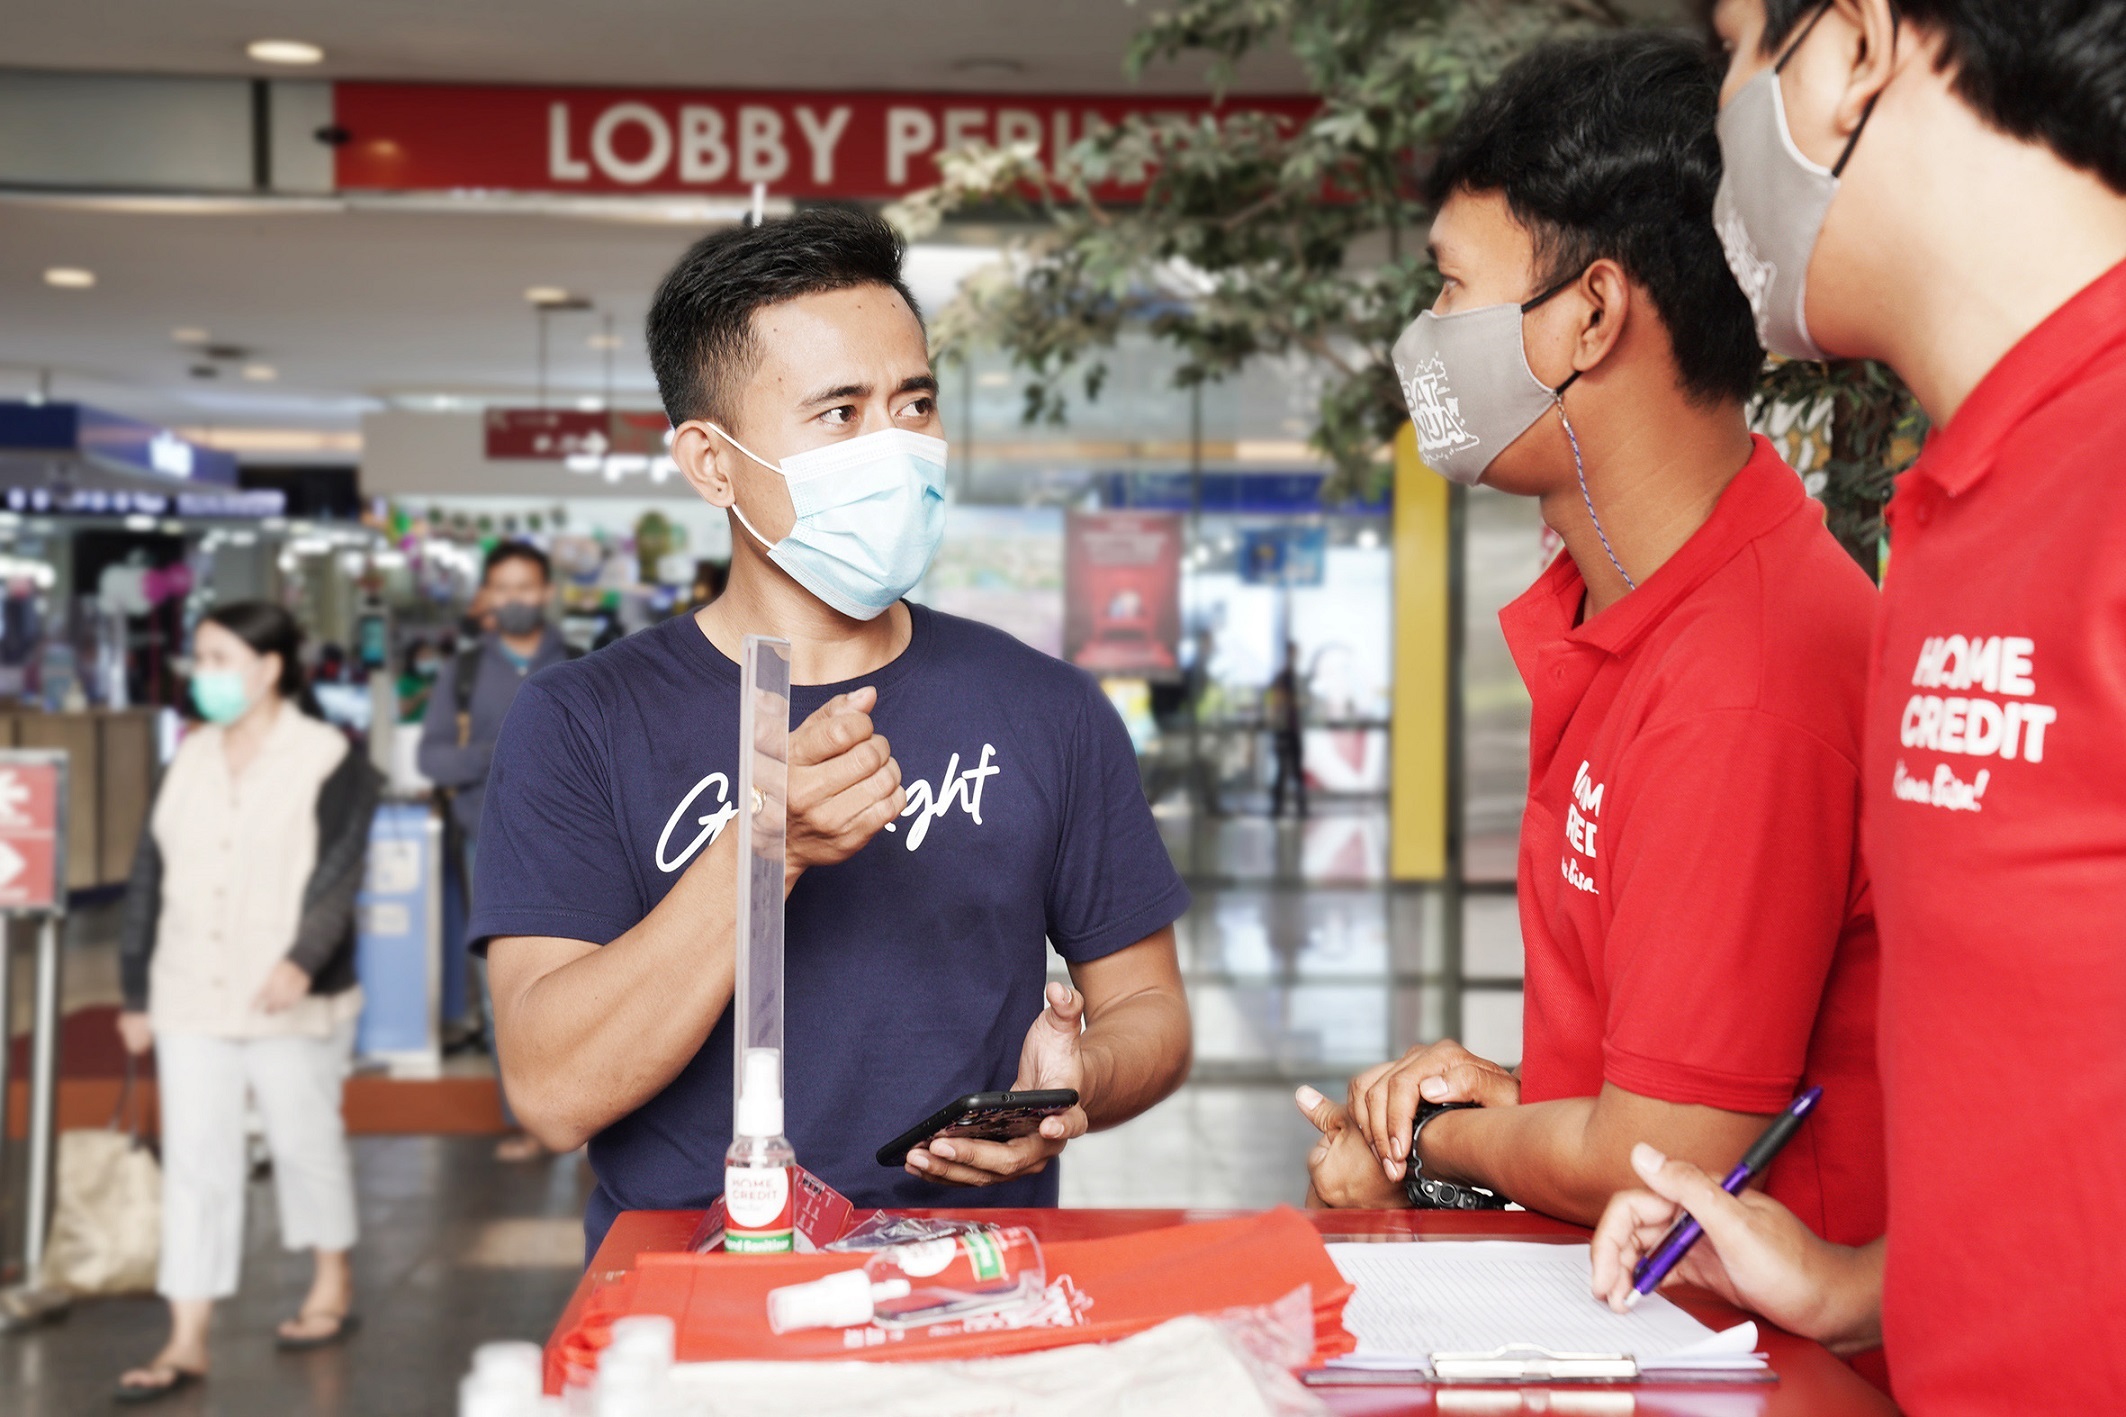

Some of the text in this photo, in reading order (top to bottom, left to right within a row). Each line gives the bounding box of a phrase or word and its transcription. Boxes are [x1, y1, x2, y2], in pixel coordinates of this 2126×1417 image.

[549, 101, 852, 184] LOBBY
[1911, 633, 2036, 697] HOME
[1900, 694, 2058, 764] CREDIT
